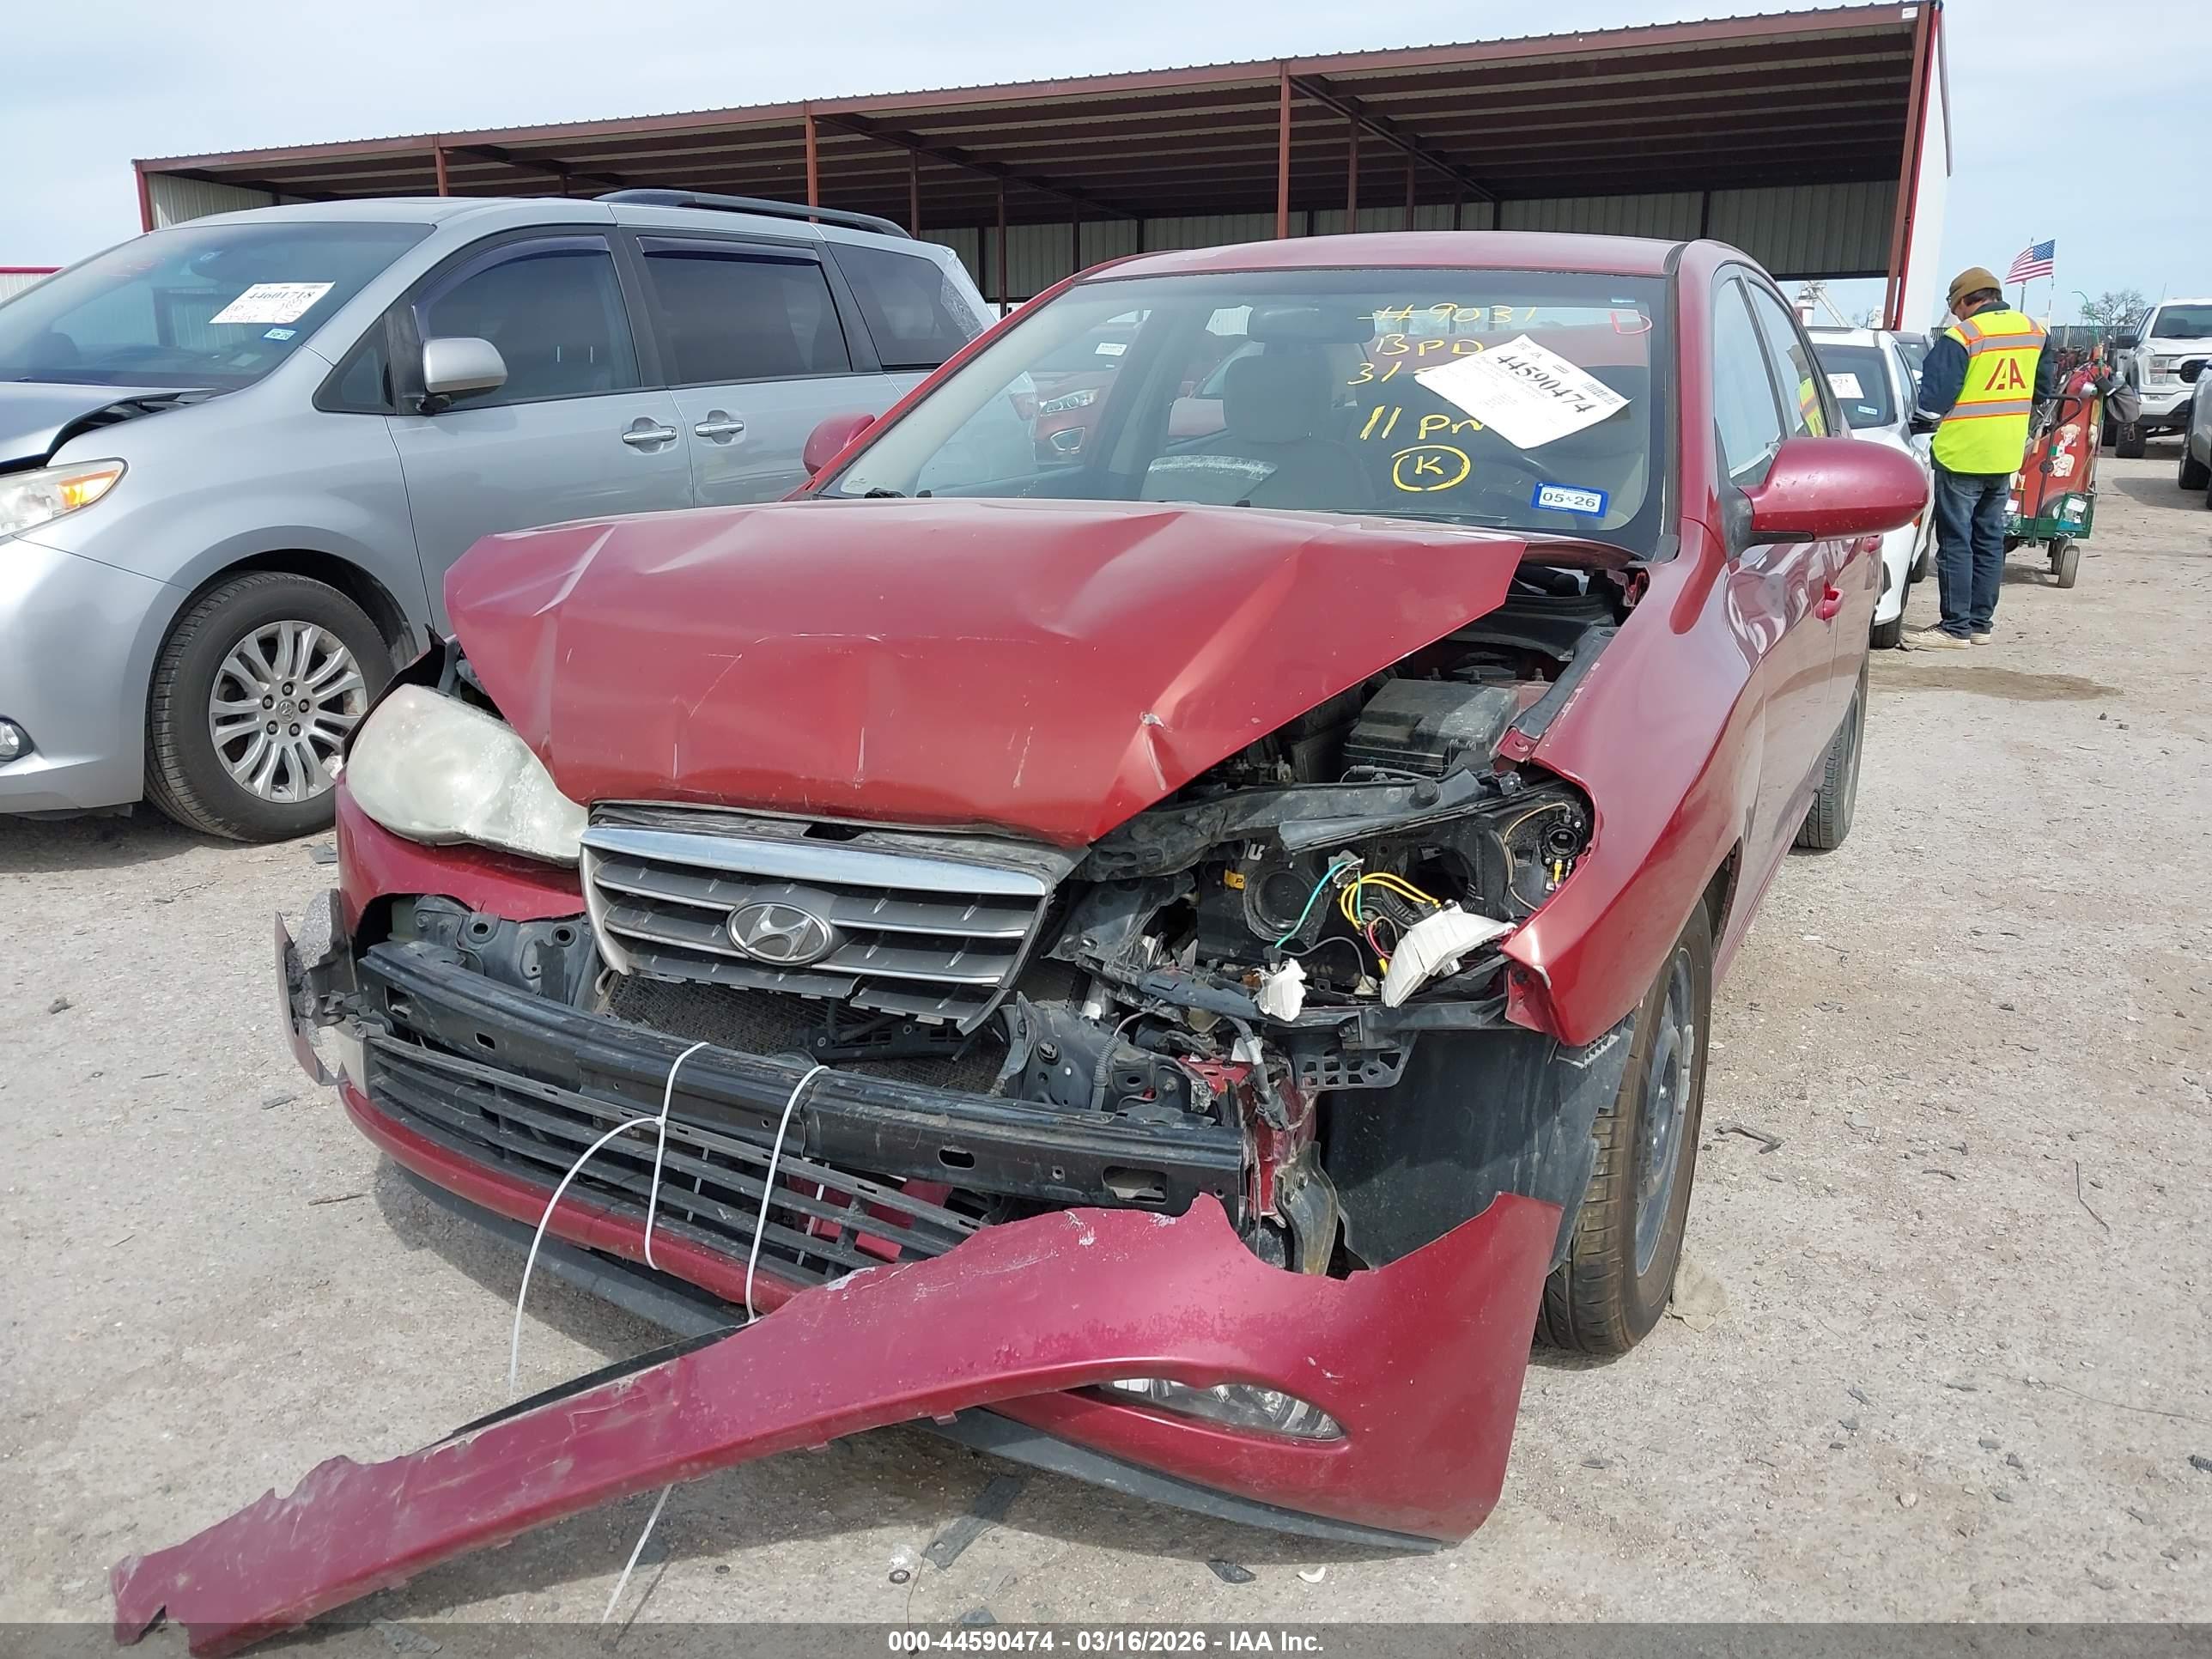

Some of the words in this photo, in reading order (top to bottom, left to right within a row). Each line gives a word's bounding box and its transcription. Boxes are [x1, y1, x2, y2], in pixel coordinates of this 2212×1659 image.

[1497, 356, 1597, 413] 44590474
[1414, 455, 1444, 475] K
[1543, 492, 1565, 503] 05
[1574, 496, 1596, 507] 26
